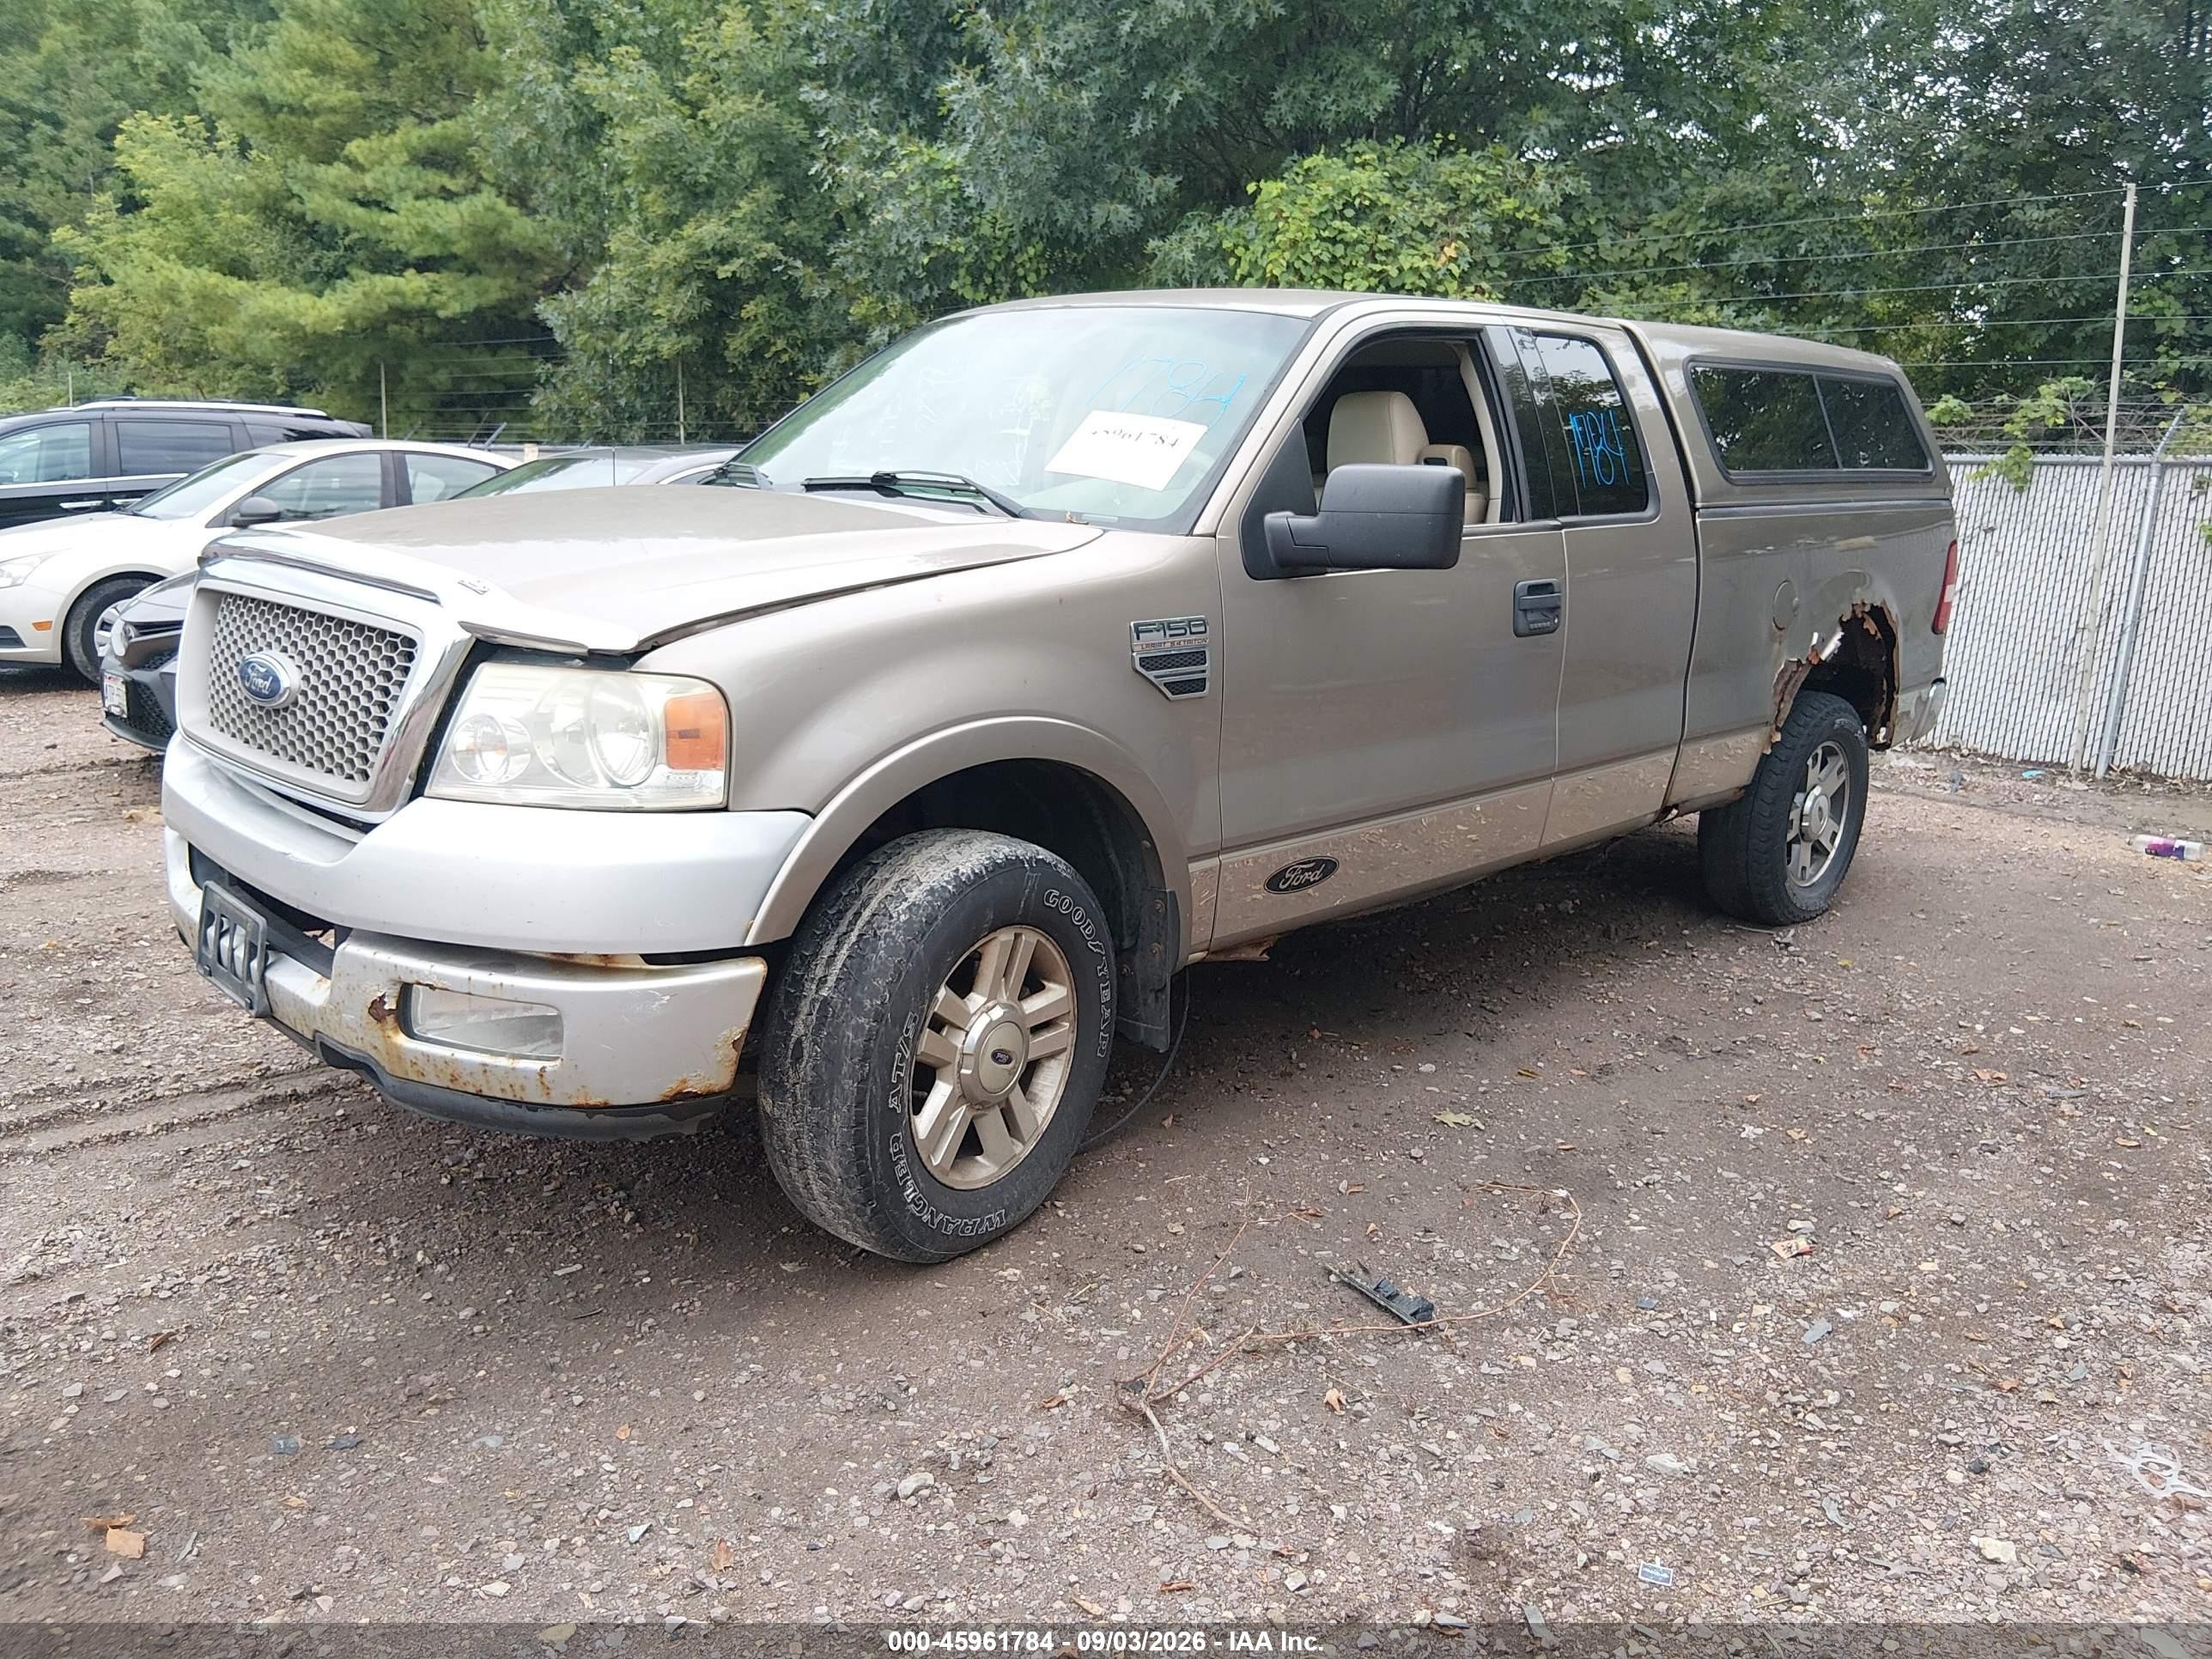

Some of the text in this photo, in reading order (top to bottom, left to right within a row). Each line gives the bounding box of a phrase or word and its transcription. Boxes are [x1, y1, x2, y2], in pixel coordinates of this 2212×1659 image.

[245, 663, 273, 695] Ford
[1279, 862, 1326, 890] Ford
[890, 1132, 1006, 1237] WRANGLER
